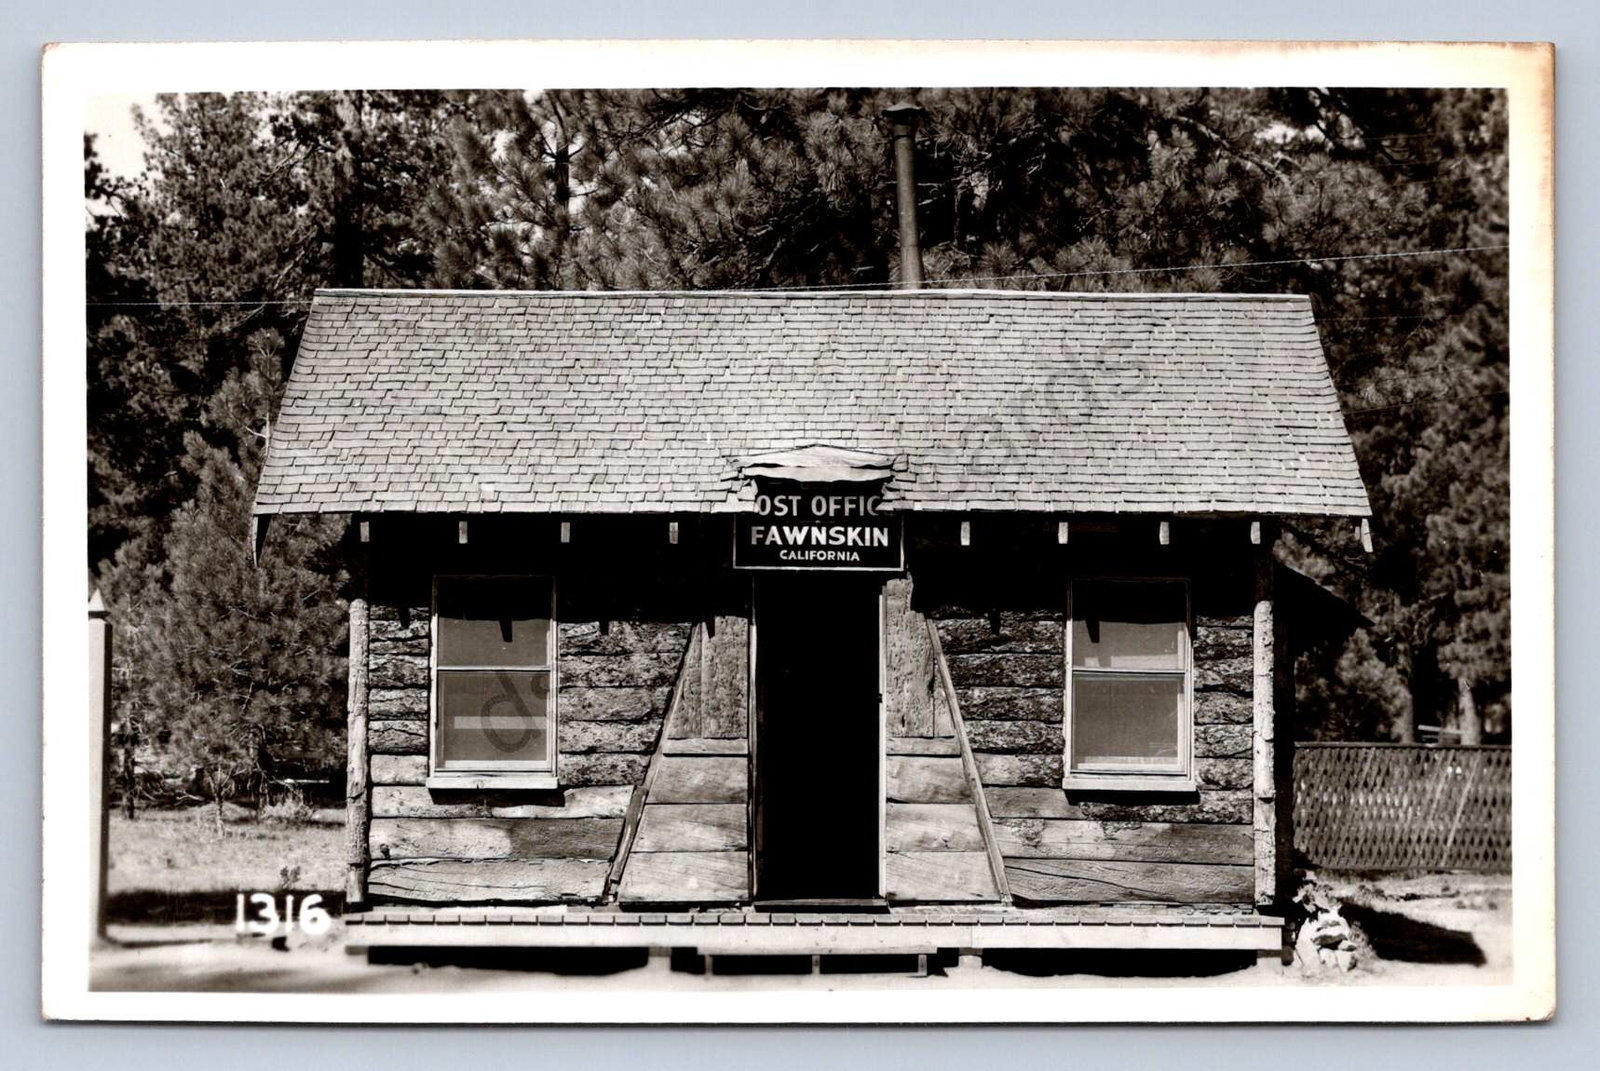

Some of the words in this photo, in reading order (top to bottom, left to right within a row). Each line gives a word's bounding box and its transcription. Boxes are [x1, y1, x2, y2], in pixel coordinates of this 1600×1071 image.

[756, 495, 802, 517] OST
[811, 495, 880, 517] OFFIC
[751, 525, 889, 547] FAWNSKIN
[779, 549, 860, 562] CALIFORNIA
